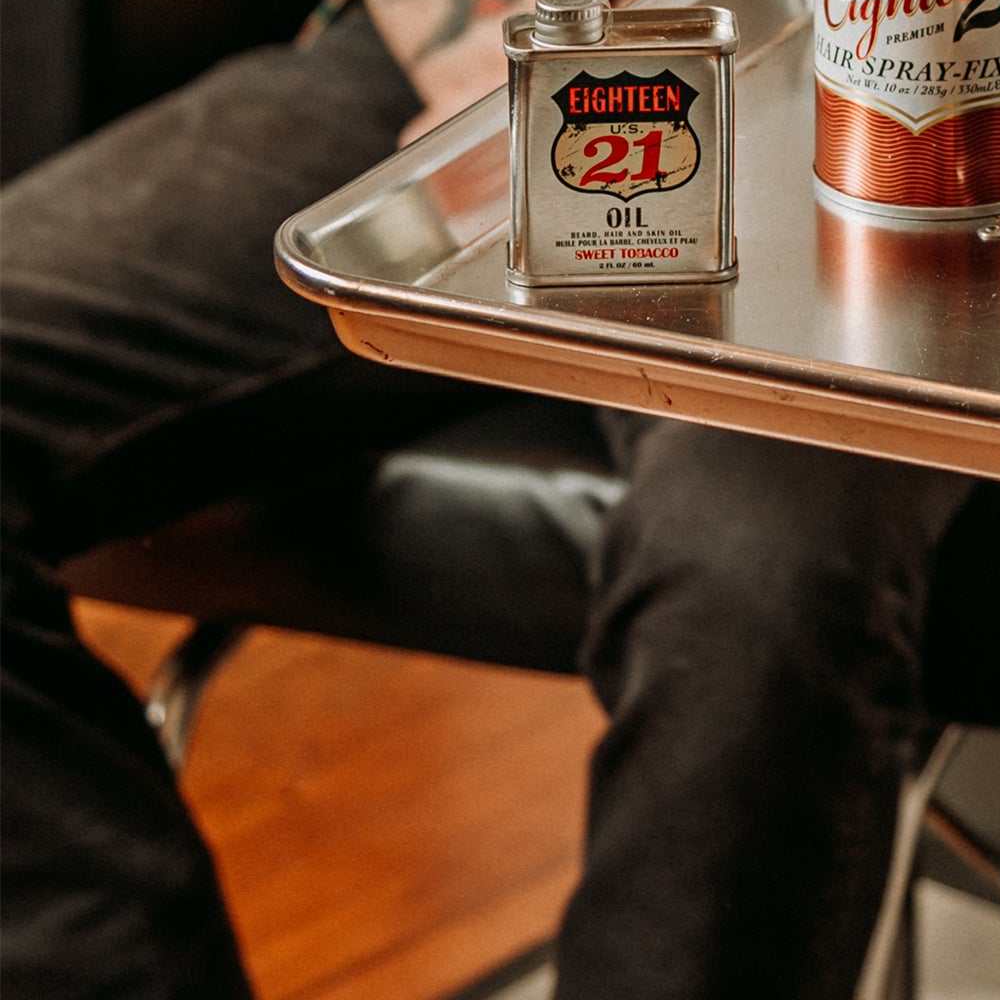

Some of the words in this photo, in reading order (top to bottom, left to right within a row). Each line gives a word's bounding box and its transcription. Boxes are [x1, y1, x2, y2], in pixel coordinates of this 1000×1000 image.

[886, 23, 946, 45] PREMIUM
[816, 33, 853, 71] HAIR
[846, 74, 861, 86] Net
[884, 83, 897, 92] 10
[920, 85, 947, 99] 283g
[569, 85, 681, 114] EIGHTEEN
[610, 123, 644, 134] U.S.
[579, 130, 668, 187] 21
[606, 207, 649, 228] OIL
[578, 239, 598, 247] POUR
[637, 237, 668, 245] CHEVEUX
[574, 248, 616, 261] SWEET
[619, 247, 679, 259] TOBACCO
